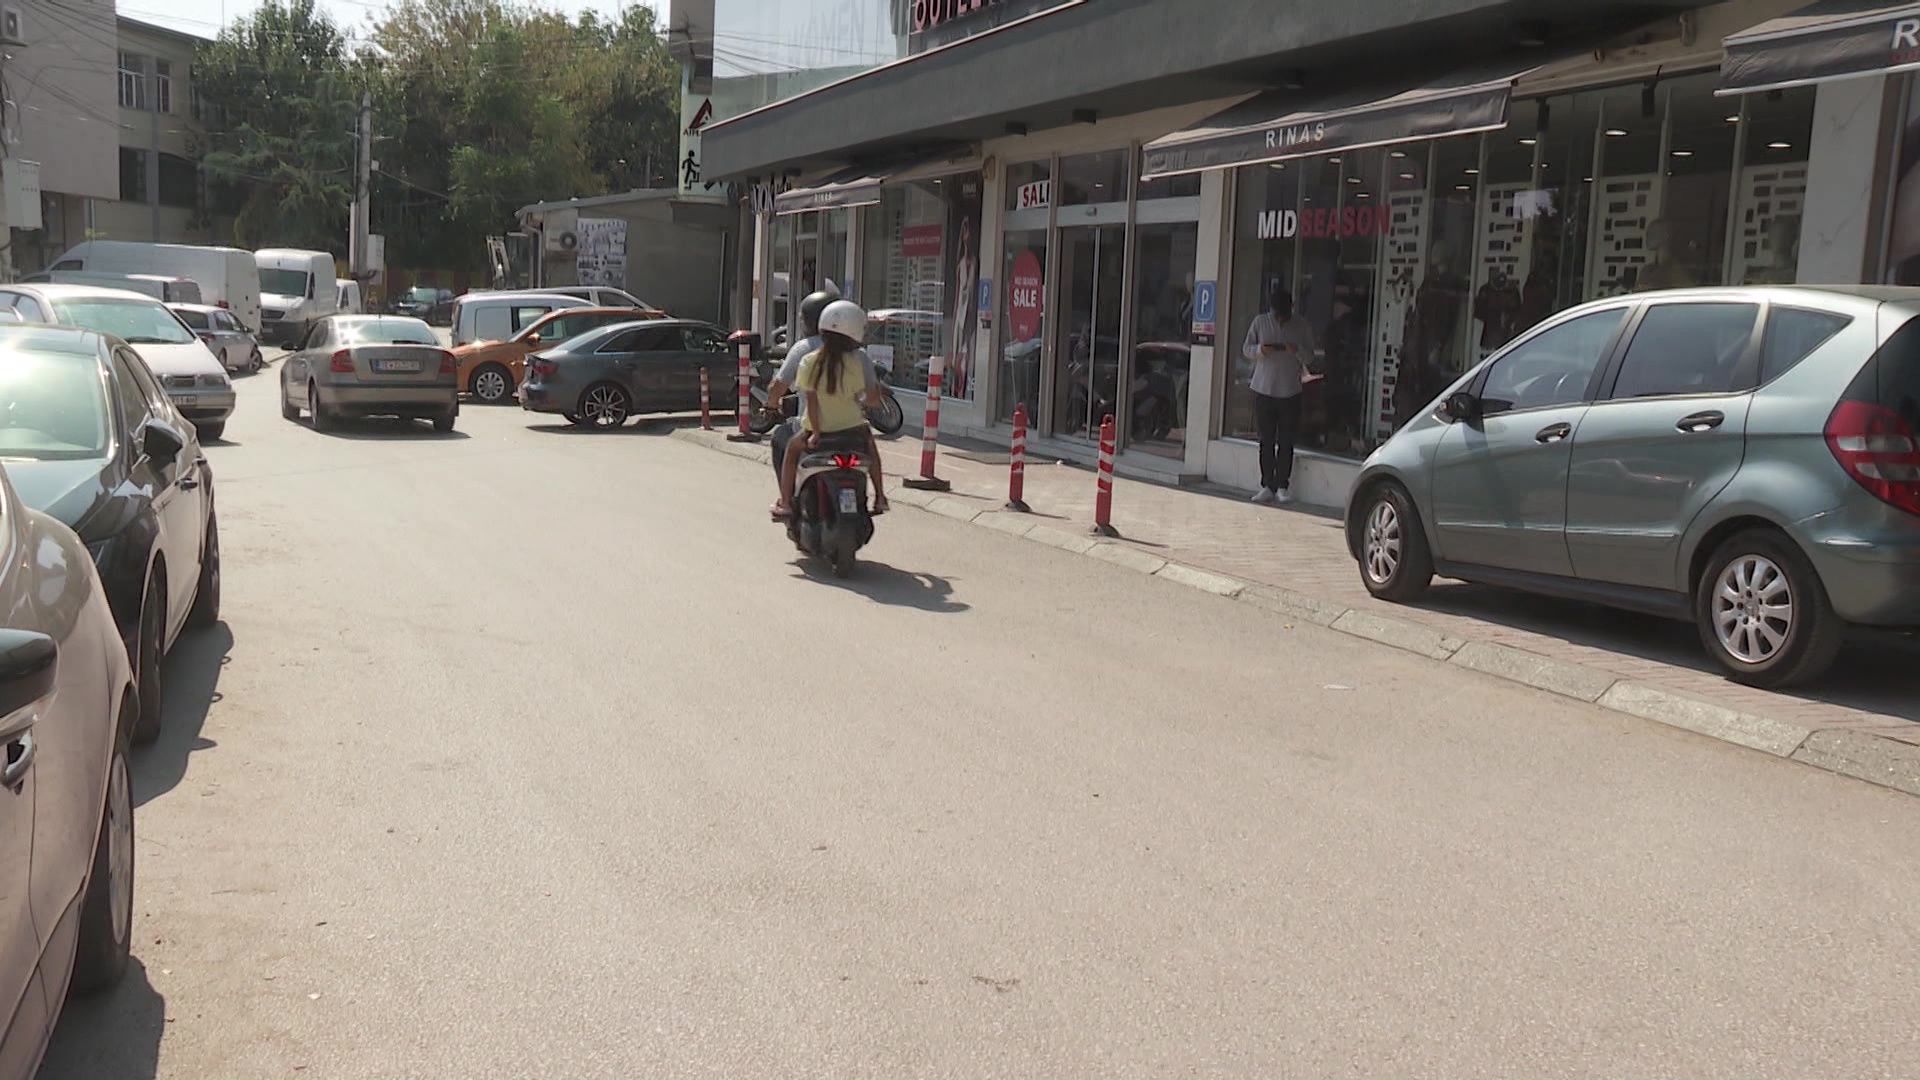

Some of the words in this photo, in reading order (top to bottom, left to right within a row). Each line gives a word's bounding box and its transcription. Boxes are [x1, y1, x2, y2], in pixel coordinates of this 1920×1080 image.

[1265, 122, 1325, 148] RINAS
[1257, 209, 1297, 239] MID
[1301, 203, 1391, 239] SEASON
[1013, 288, 1037, 307] SALE
